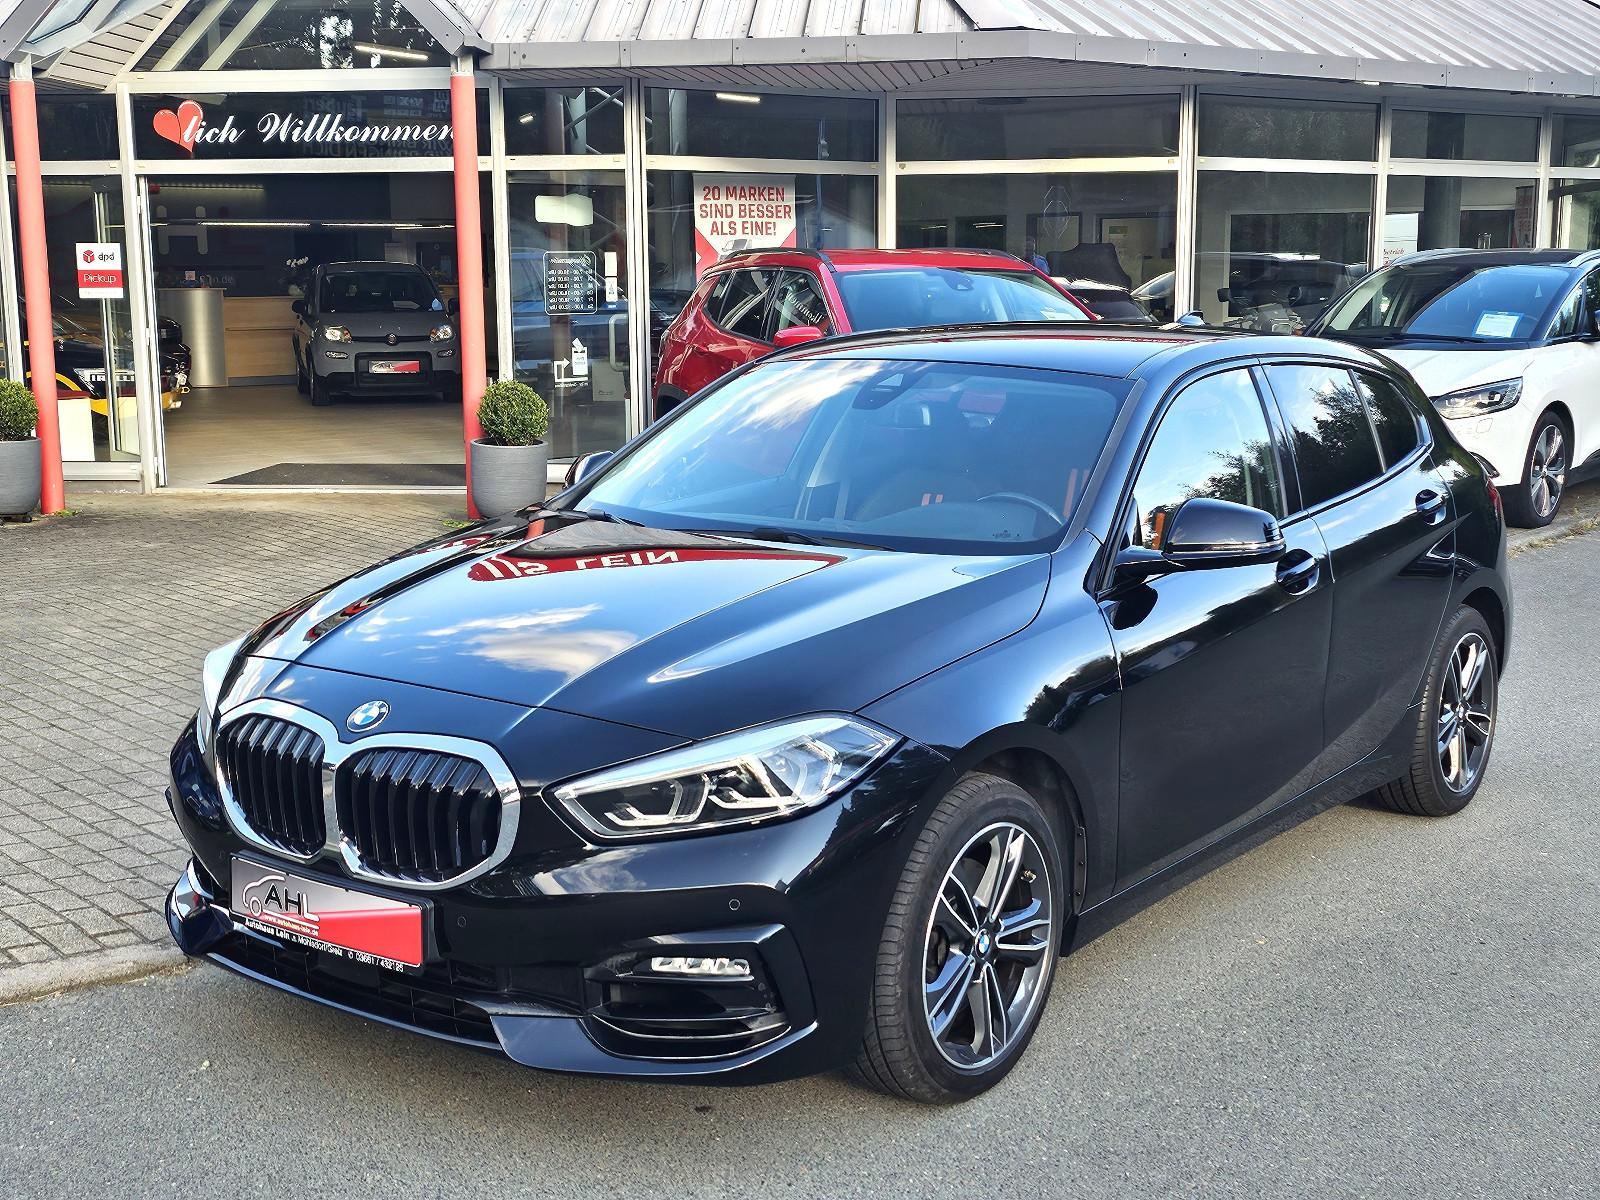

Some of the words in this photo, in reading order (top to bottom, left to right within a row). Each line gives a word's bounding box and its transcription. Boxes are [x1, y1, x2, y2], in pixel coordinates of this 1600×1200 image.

[182, 115, 246, 143] lich
[703, 186, 721, 201] 20
[725, 186, 785, 202] MARKEN
[700, 203, 734, 218] SIND
[738, 204, 792, 219] BESSER
[710, 221, 738, 235] ALS
[741, 222, 777, 236] EINE!
[98, 252, 115, 262] dpd
[83, 273, 117, 284] Pickup
[264, 883, 320, 922] AHL
[245, 918, 274, 935] Autohaus
